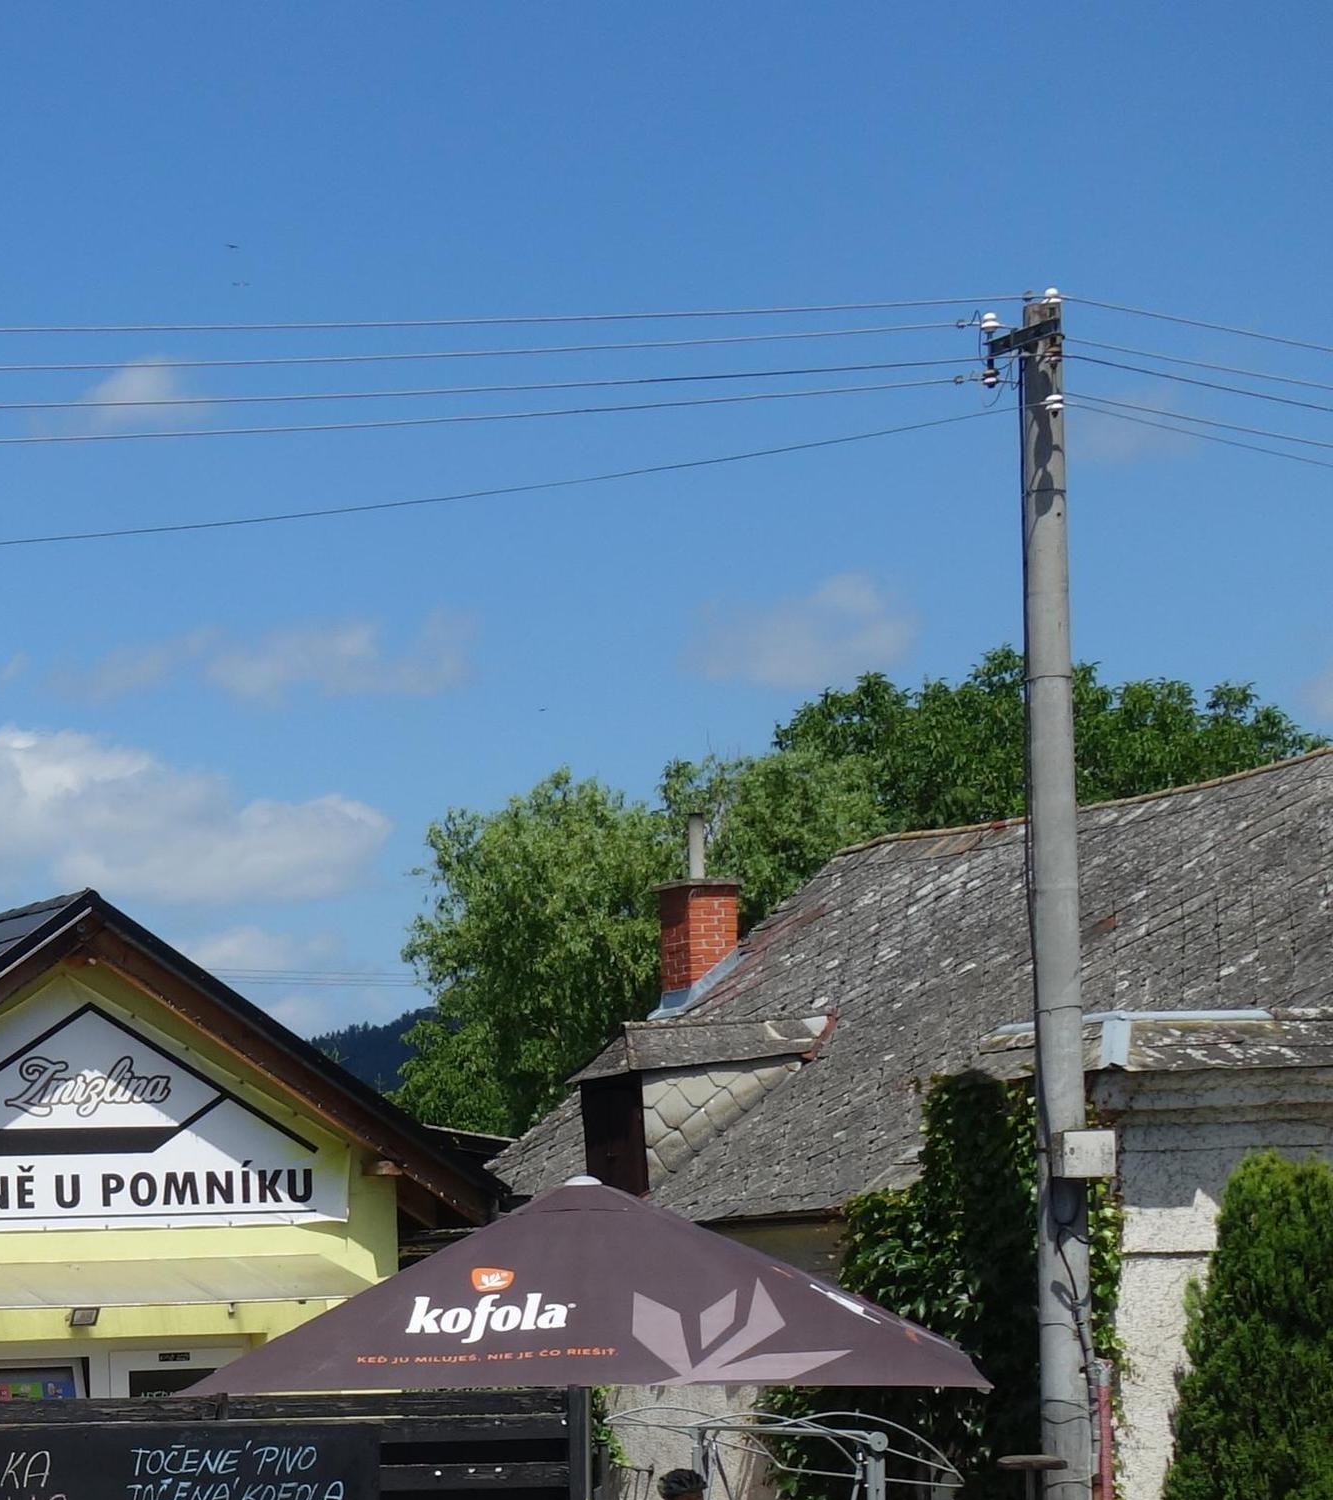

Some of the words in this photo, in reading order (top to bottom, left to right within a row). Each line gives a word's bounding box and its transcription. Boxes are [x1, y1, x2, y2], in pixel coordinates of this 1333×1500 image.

[6, 1056, 172, 1117] Zmrzlina
[55, 1174, 80, 1209] U
[102, 1160, 313, 1208] POMNÍKU
[405, 1293, 568, 1343] kofola
[392, 1356, 409, 1364] JU
[487, 1352, 512, 1360] NIE
[517, 1350, 534, 1359] JE
[131, 1440, 252, 1476] TOČENÉ
[253, 1446, 317, 1476] PIVO
